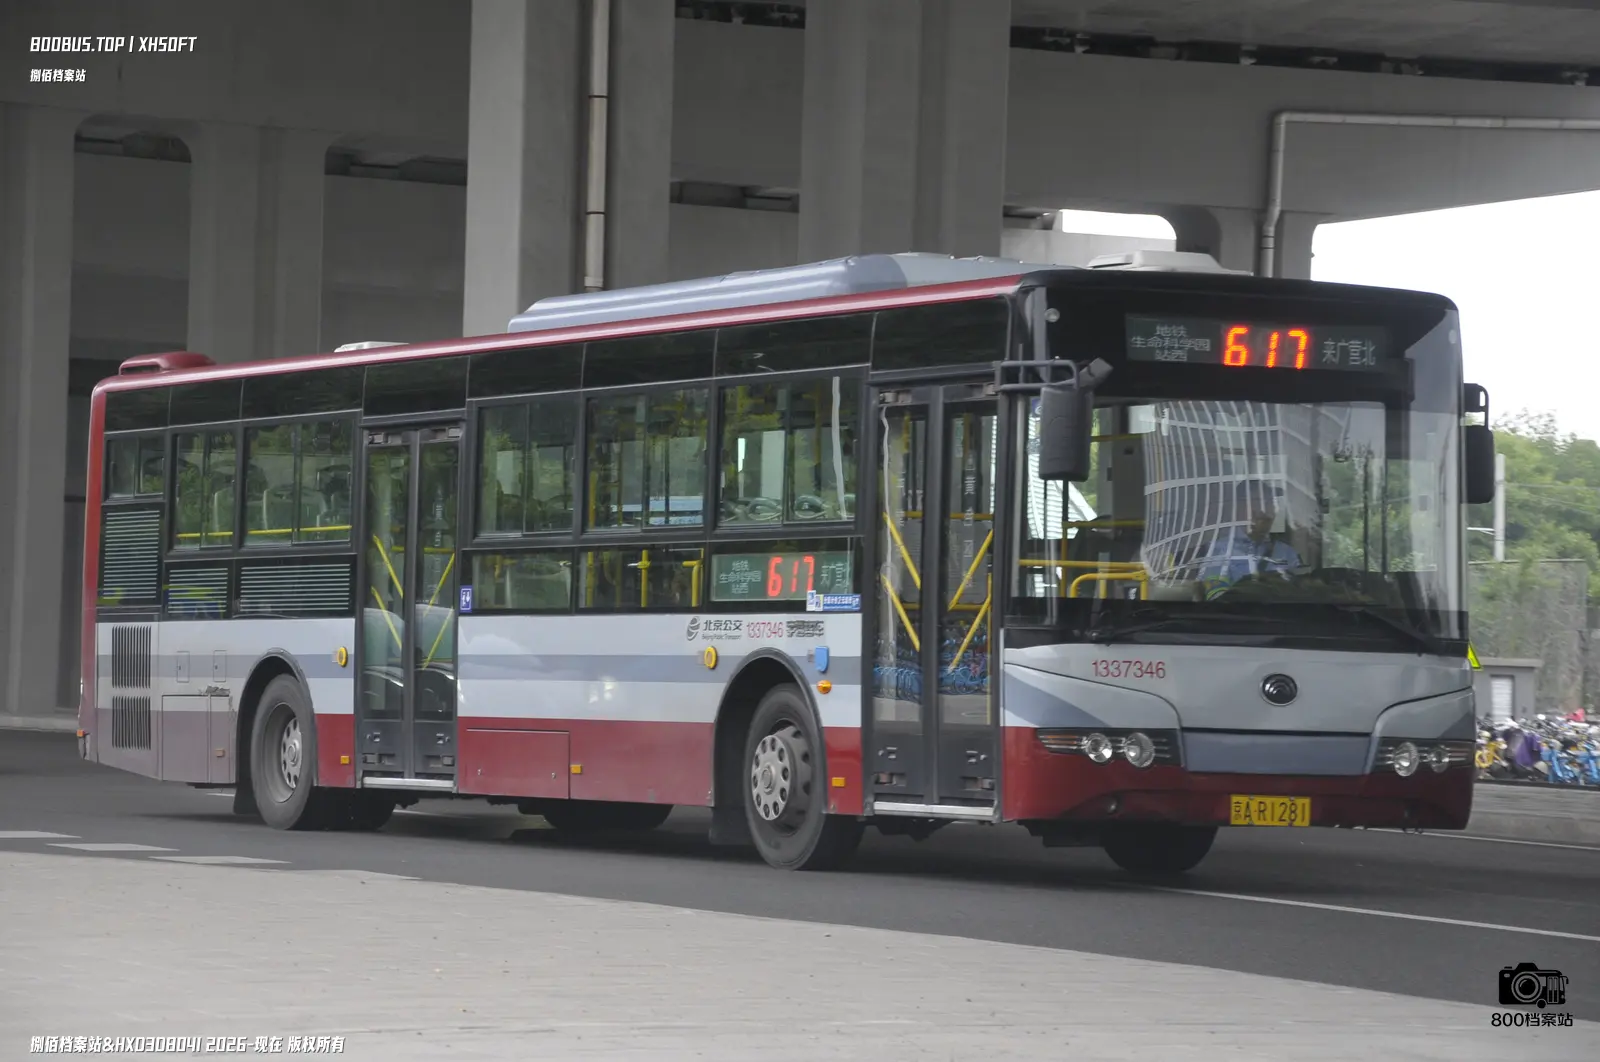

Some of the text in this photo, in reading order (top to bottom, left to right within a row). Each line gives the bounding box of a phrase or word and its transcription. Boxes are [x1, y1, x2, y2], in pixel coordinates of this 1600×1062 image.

[1154, 325, 1187, 337] 地铁
[1130, 336, 1211, 351] 生命科学园
[1223, 326, 1308, 369] 617
[1322, 338, 1377, 366] 来广营北
[767, 555, 815, 597] 617
[703, 619, 743, 631] 北京公交
[746, 621, 784, 639] 1337346
[1092, 660, 1167, 679] 1337346
